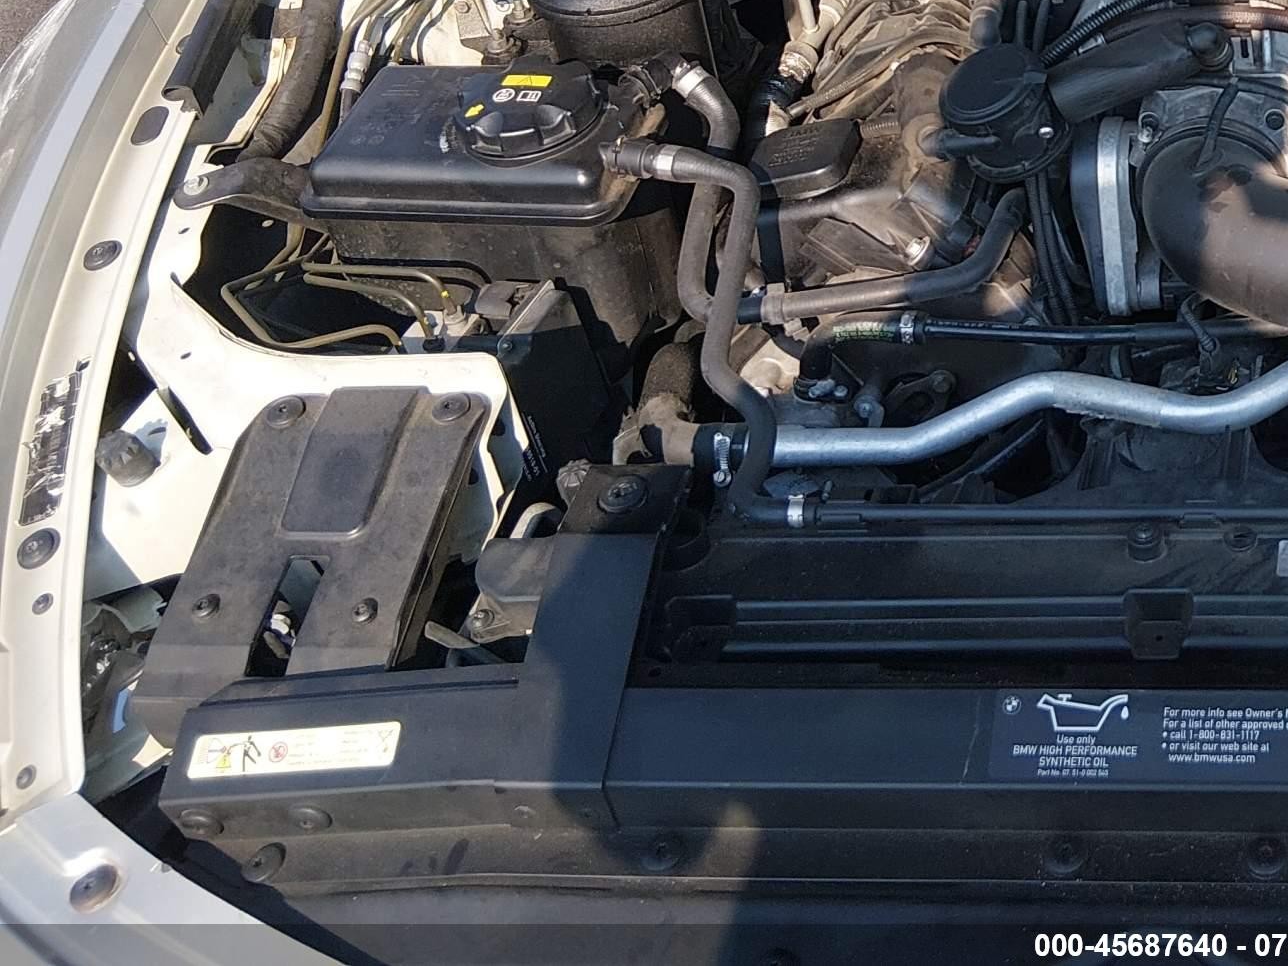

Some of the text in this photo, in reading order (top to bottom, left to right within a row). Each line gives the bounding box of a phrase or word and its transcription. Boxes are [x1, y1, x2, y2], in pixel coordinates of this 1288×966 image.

[1164, 707, 1178, 717] For
[1208, 708, 1224, 717] info
[1245, 708, 1282, 718] Owner's
[1163, 719, 1178, 728] For
[1189, 719, 1202, 728] list
[1205, 719, 1213, 728] of
[1216, 720, 1240, 728] other
[1241, 720, 1284, 730] approved
[1057, 734, 1096, 745] Use only
[1170, 730, 1259, 740] call 1-800-831-1117
[1013, 745, 1138, 756] BMW HIGH PERFORMANCE
[1182, 742, 1200, 750] visit
[1220, 742, 1239, 751] web
[1241, 742, 1258, 751] site
[1260, 743, 1269, 751] at
[1039, 756, 1108, 766] SYNTHETIC OIL
[1168, 753, 1256, 762] www.bmwusa.com
